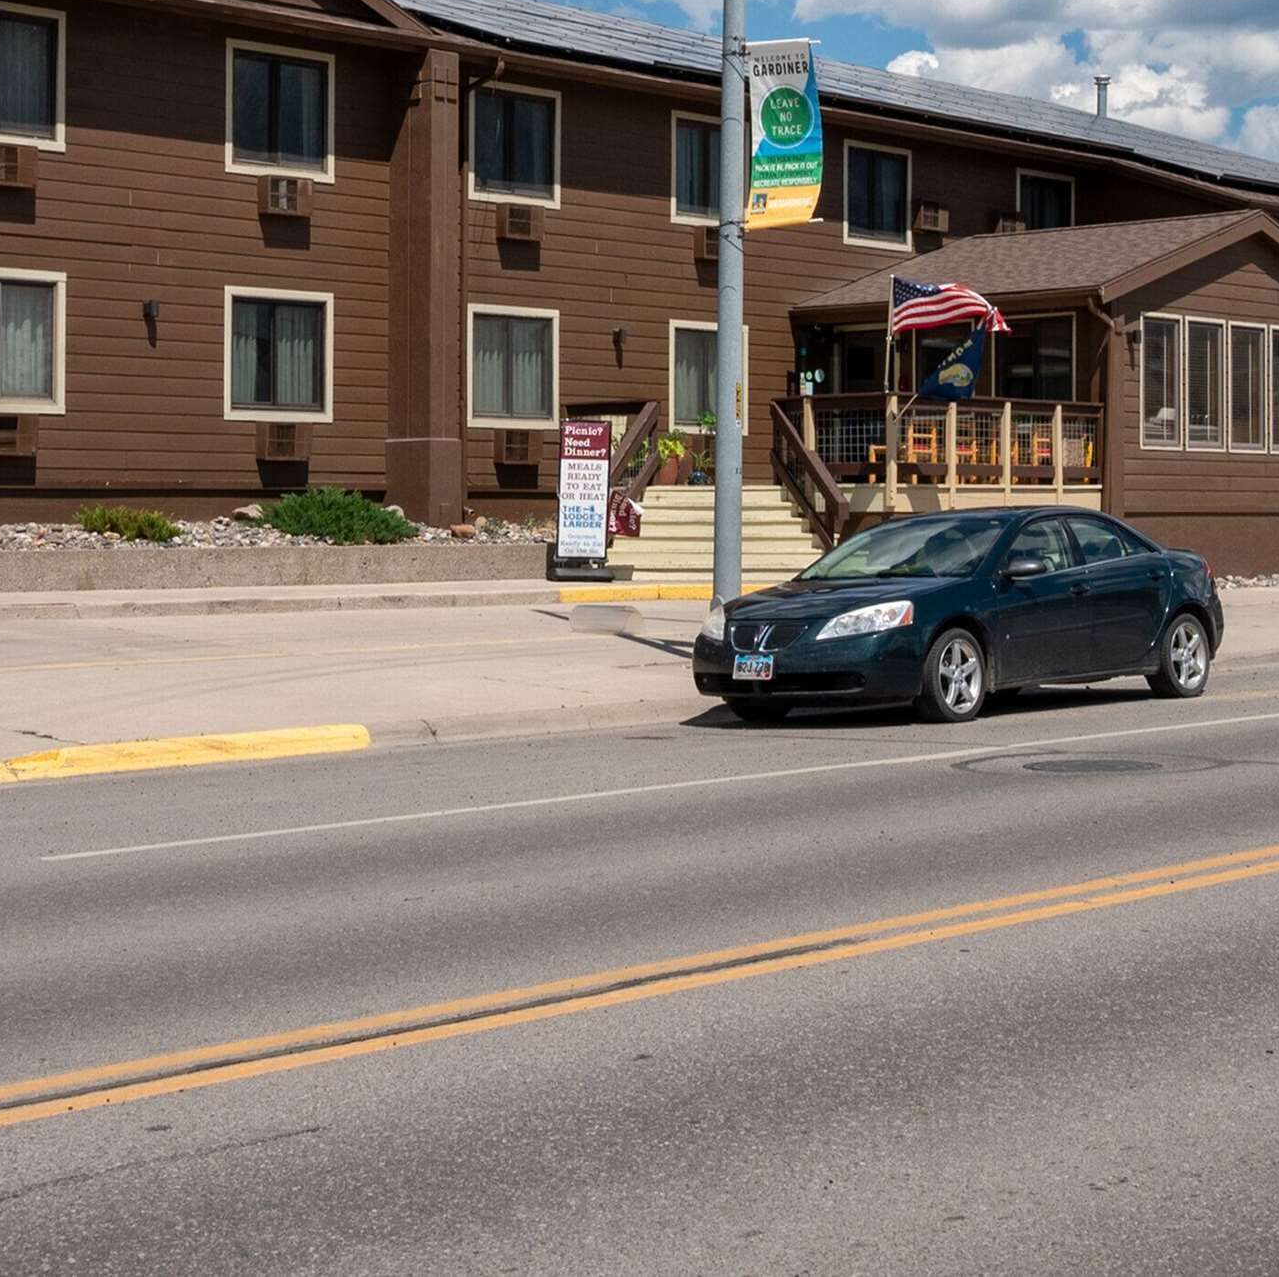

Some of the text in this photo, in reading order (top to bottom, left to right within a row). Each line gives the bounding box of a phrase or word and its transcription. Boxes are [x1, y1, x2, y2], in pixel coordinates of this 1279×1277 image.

[752, 61, 809, 77] GARDINER
[770, 97, 800, 109] LEAVE
[779, 111, 792, 122] NO
[771, 124, 802, 136] TRACE
[564, 425, 603, 436] Picnic?
[564, 437, 591, 447] Need
[564, 448, 607, 457] Dinner?
